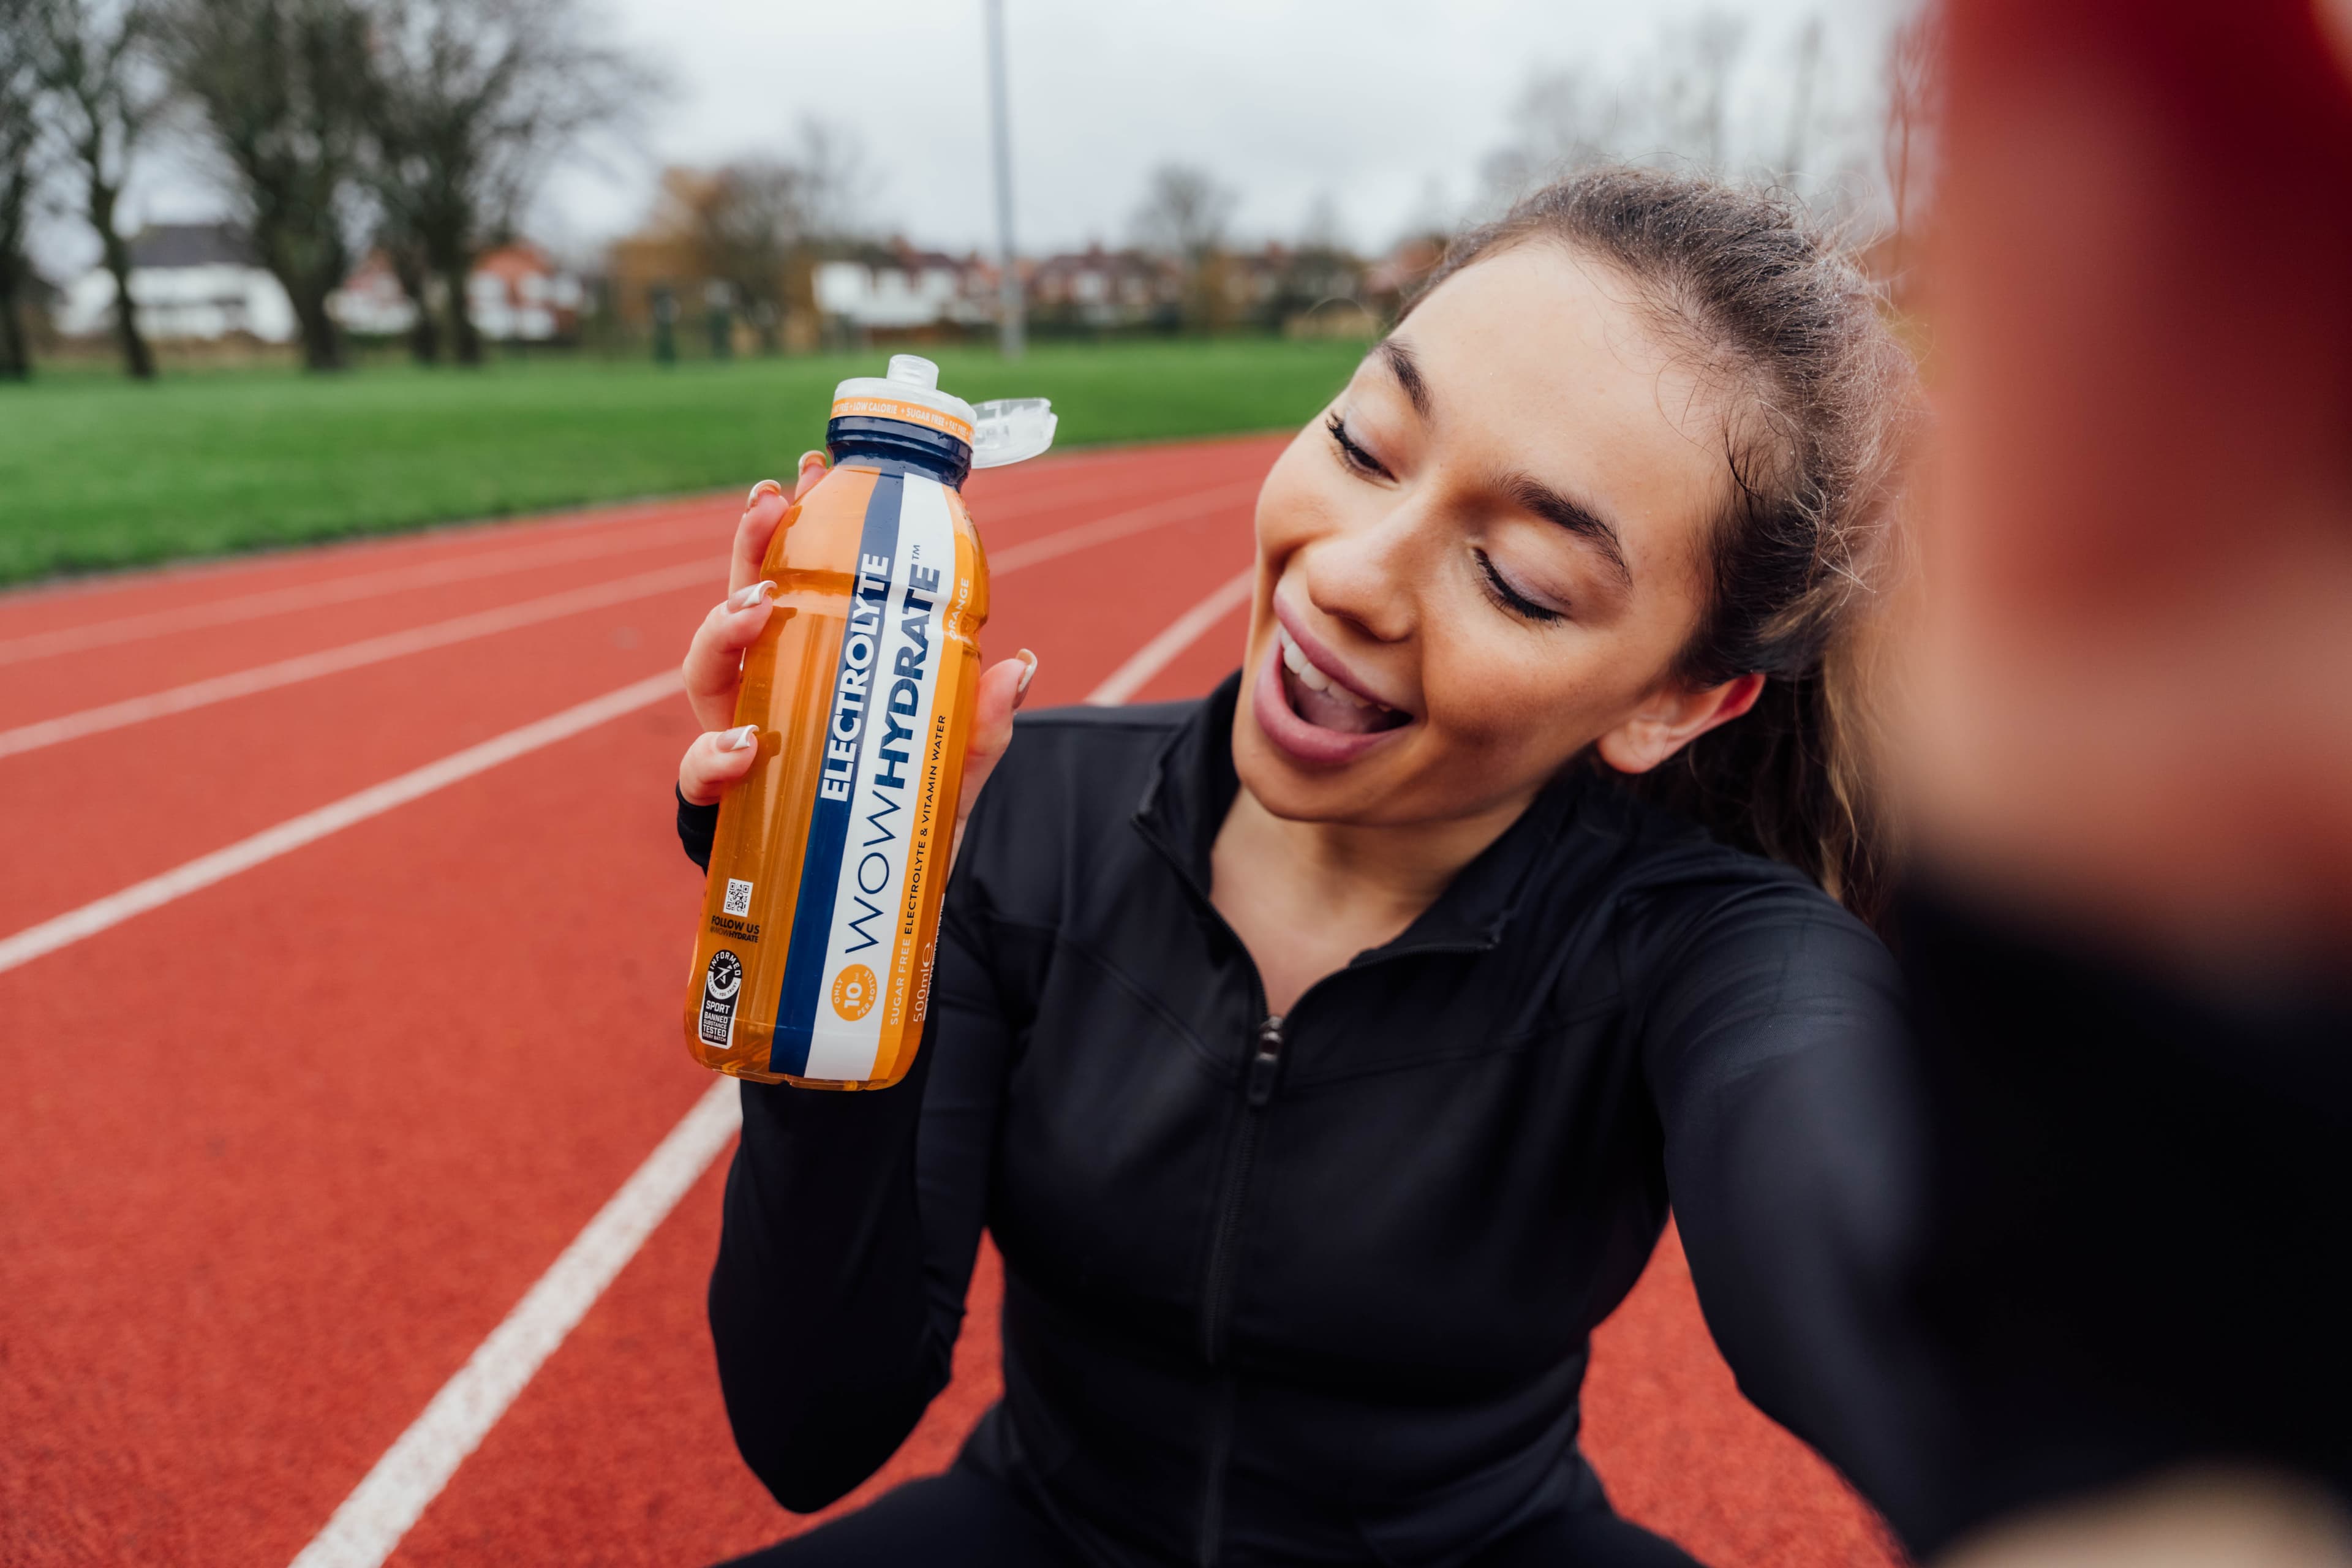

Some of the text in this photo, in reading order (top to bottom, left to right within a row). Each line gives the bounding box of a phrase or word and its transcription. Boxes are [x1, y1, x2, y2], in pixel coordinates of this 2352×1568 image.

[853, 402, 869, 412] LOW
[868, 402, 897, 414] CALORIE
[907, 408, 930, 422] SUGAR
[931, 414, 946, 427] FREE
[949, 578, 969, 641] ORANGE
[820, 553, 889, 802] ELECTROLYTE
[891, 715, 946, 1025] SUGAR FREE ELECTROLYTE & VITAMIN WATER
[711, 915, 760, 935] FOLLOW US
[709, 952, 741, 976] INFORMED
[834, 978, 843, 1004] ONLY
[844, 982, 862, 1008] 10
[858, 970, 876, 1017] PER BOTTLE
[704, 1011, 728, 1024] BANNED
[706, 1000, 730, 1014] SPORT
[703, 1019, 727, 1030] SUBSTANCE
[703, 1024, 727, 1037] TESTED
